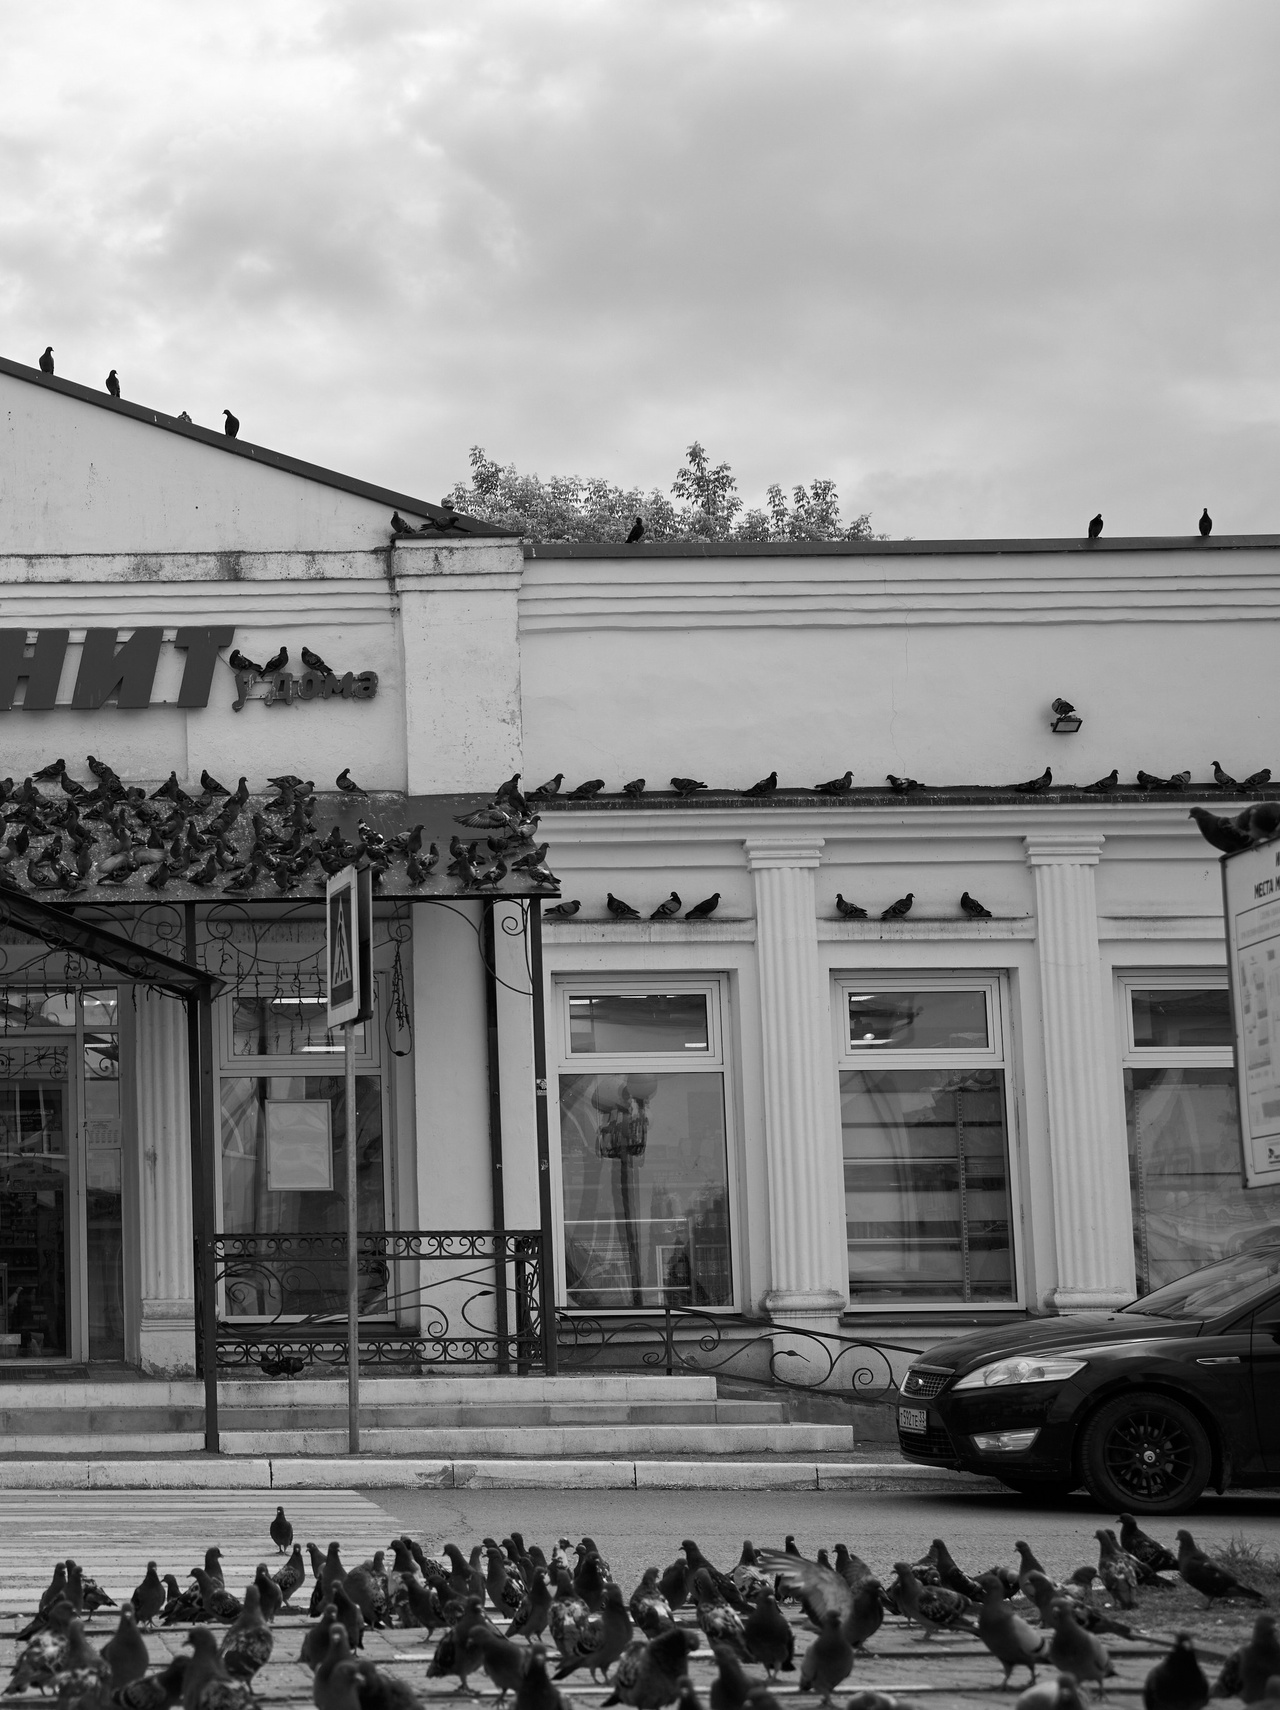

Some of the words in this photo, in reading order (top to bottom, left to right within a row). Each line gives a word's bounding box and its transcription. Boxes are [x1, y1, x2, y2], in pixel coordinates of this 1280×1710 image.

[232, 673, 257, 712] у
[264, 671, 378, 706] дома
[1254, 879, 1273, 899] МЕСТА
